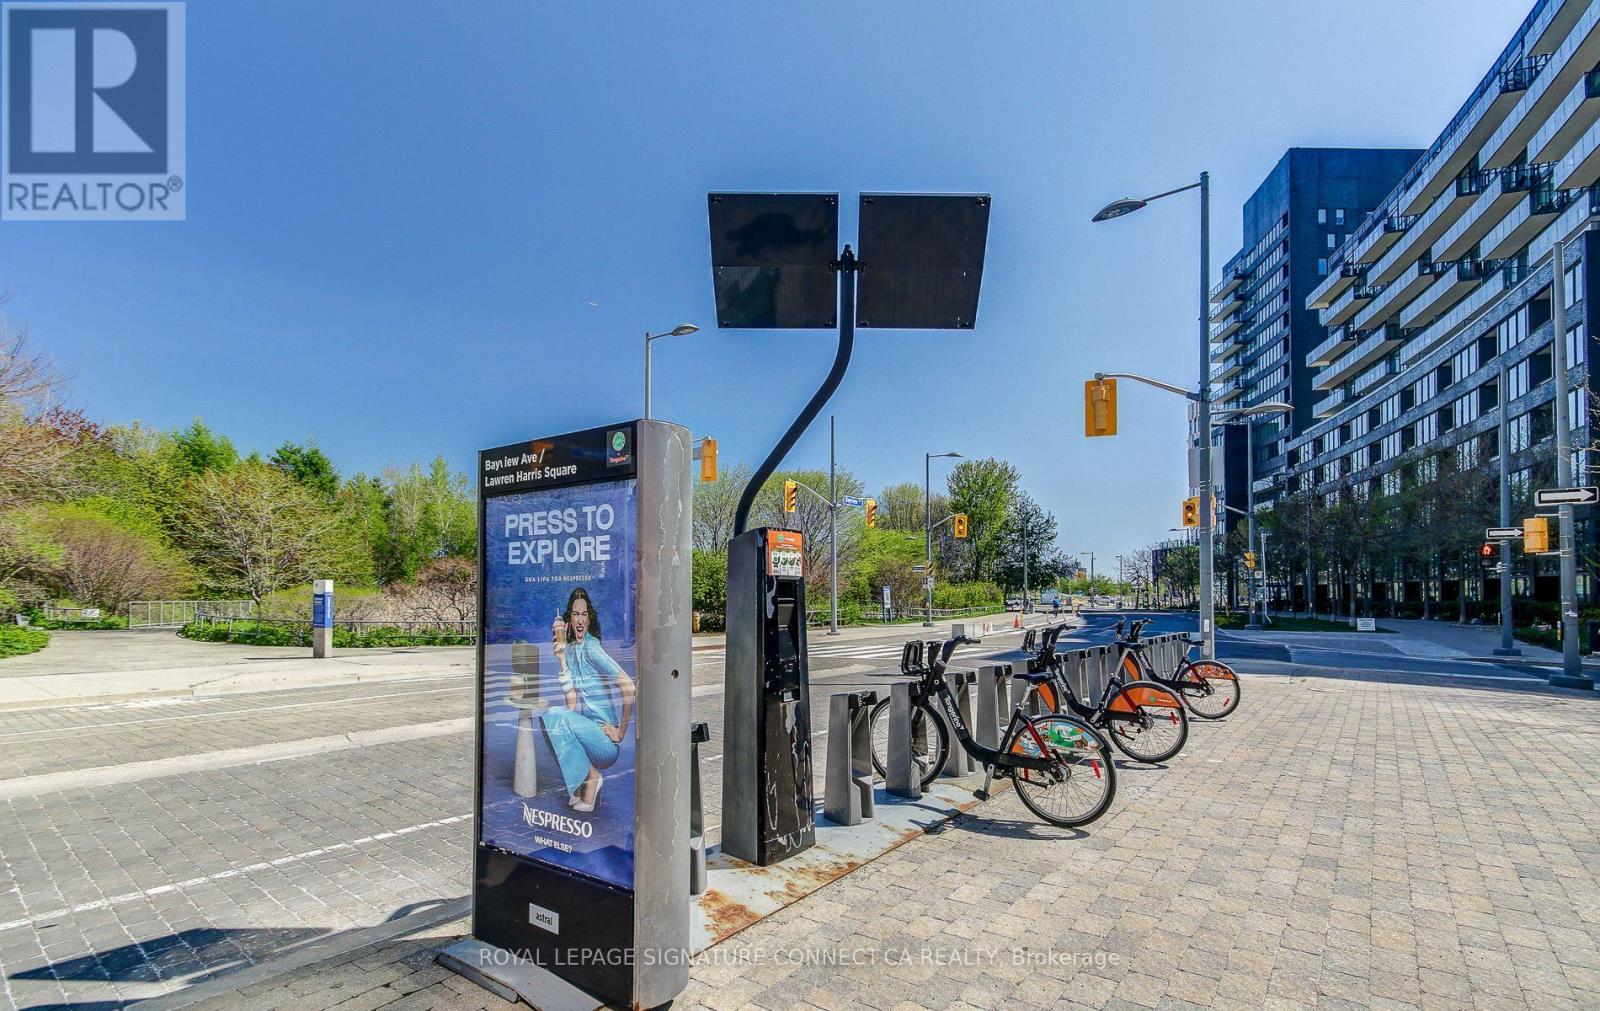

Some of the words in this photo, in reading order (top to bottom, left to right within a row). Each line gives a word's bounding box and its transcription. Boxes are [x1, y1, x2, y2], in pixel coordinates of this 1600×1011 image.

[521, 453, 537, 464] Ave
[539, 448, 545, 463] /
[485, 474, 514, 487] Lawren
[516, 468, 542, 482] Harris
[544, 464, 577, 479] Square
[504, 507, 578, 538] PRESS
[582, 503, 615, 531] TO
[508, 534, 611, 565] EXPLORE
[944, 694, 961, 728] Tangerine
[521, 801, 593, 838] NESPRESSO
[534, 835, 553, 847] WHAT
[553, 840, 573, 854] ELSE?
[535, 911, 553, 926] astral
